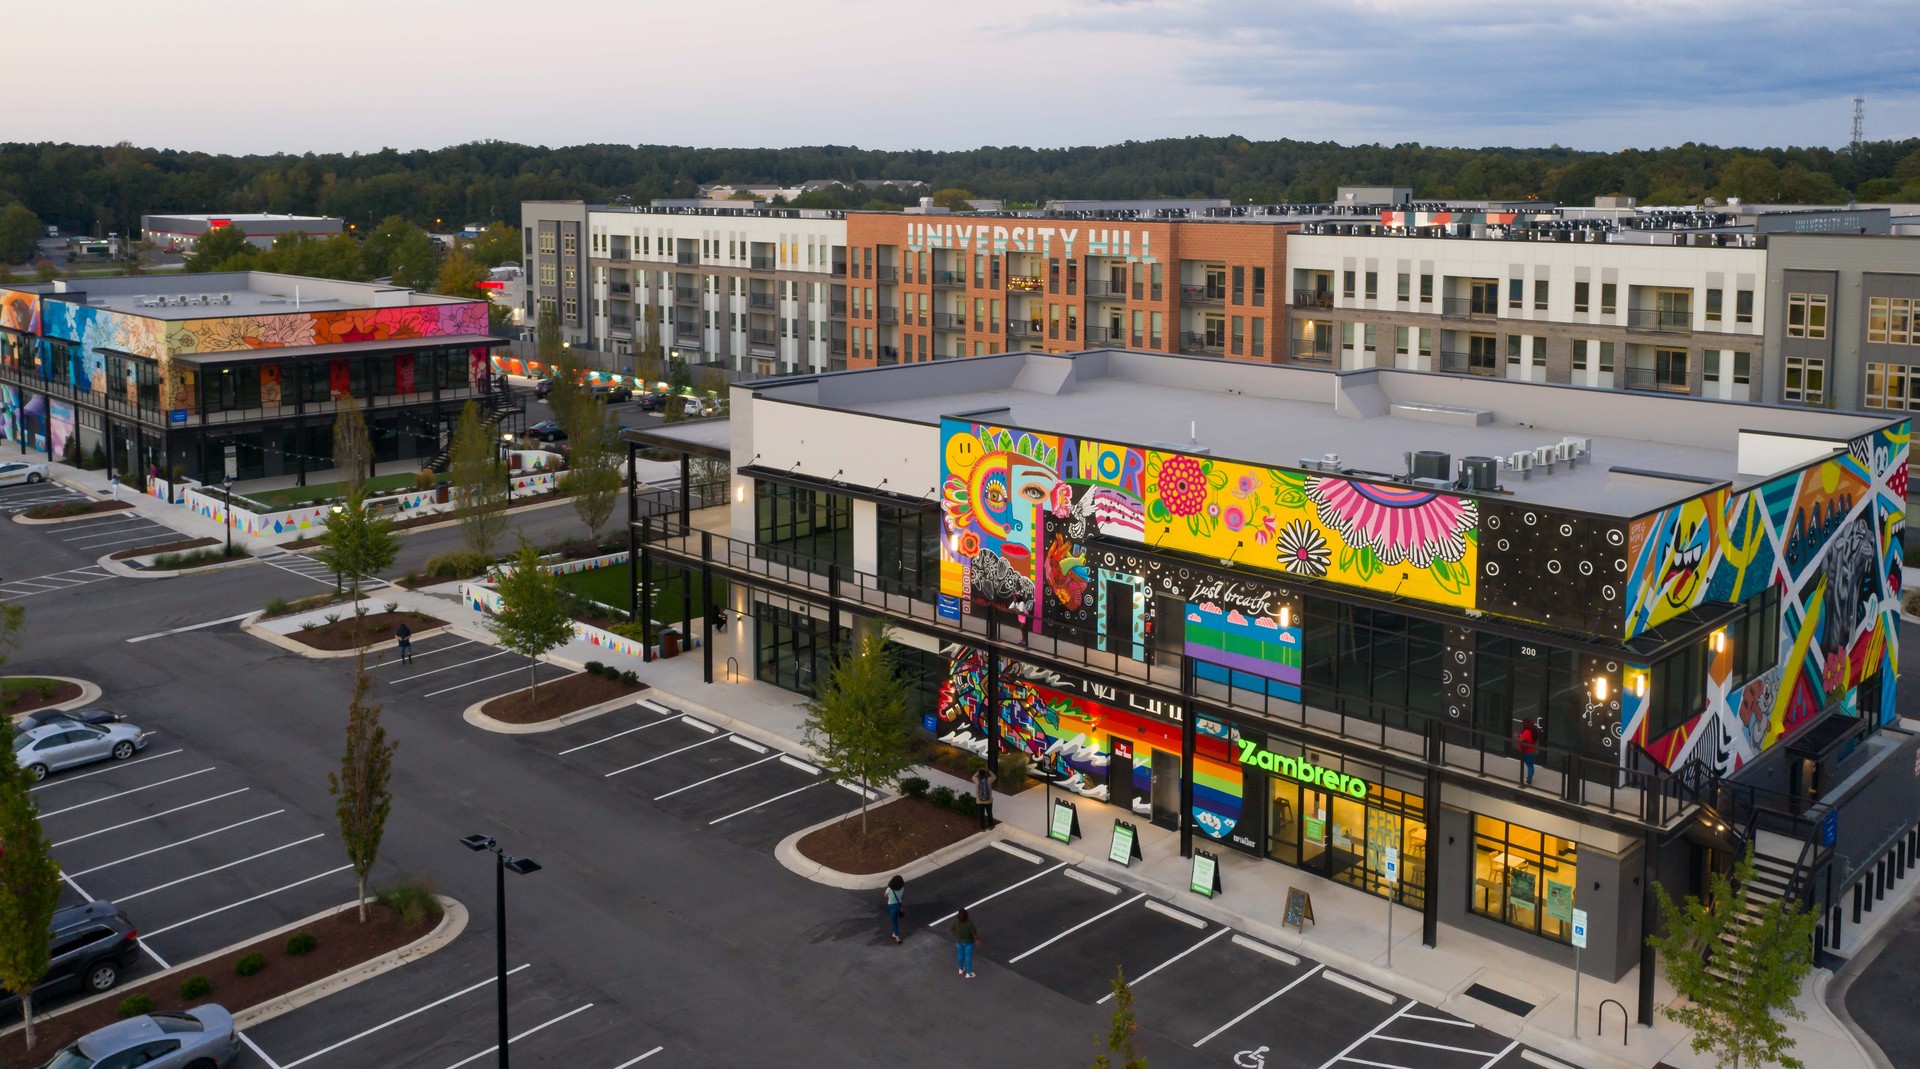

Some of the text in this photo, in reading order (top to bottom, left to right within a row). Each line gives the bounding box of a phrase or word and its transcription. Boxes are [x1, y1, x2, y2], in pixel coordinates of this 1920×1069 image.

[907, 222, 1157, 264] UNIVERSITY HILL
[1060, 437, 1144, 497] AMOR
[1223, 582, 1281, 616] breathe
[1521, 646, 1537, 657] 200
[1238, 738, 1367, 798] Zambrero
[1368, 806, 1401, 832] FEEL
